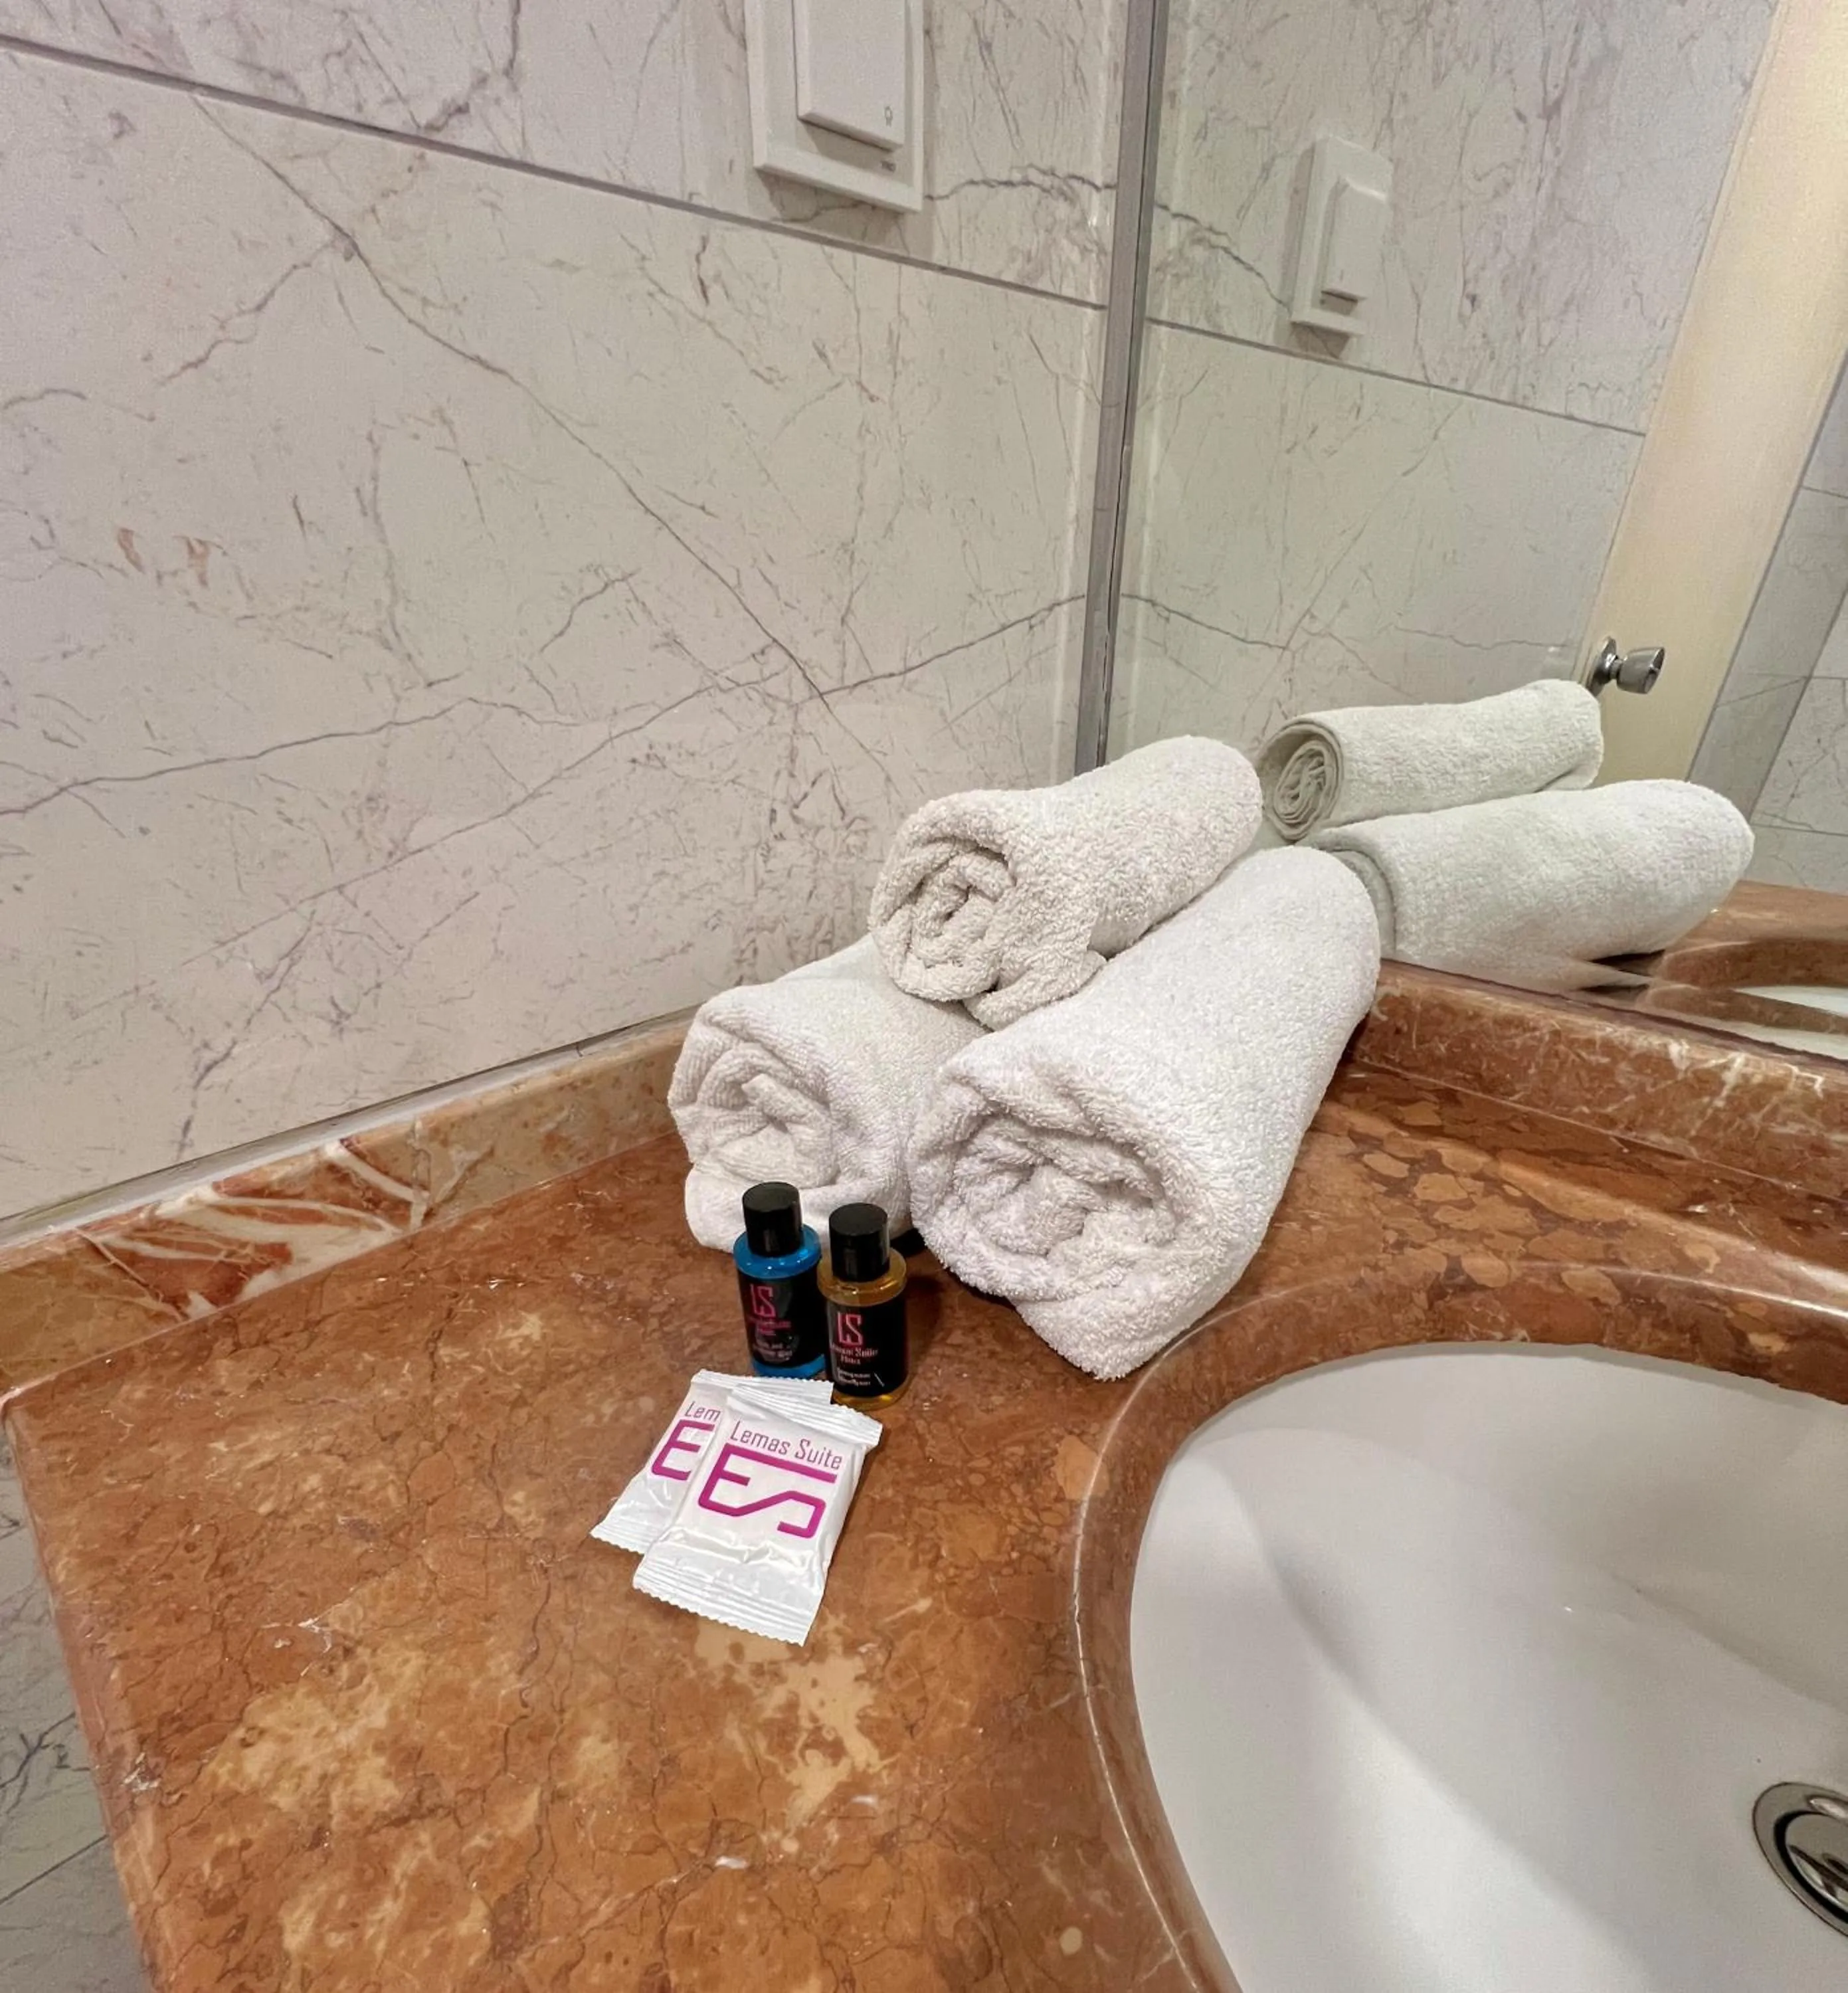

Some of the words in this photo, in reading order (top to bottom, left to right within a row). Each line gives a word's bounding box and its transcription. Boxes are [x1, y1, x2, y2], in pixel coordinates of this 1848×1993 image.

[750, 1283, 777, 1318] LS
[837, 1311, 863, 1345] LS
[684, 1401, 721, 1422] Lem
[730, 1420, 790, 1456] Lemas
[794, 1438, 842, 1470] Suite
